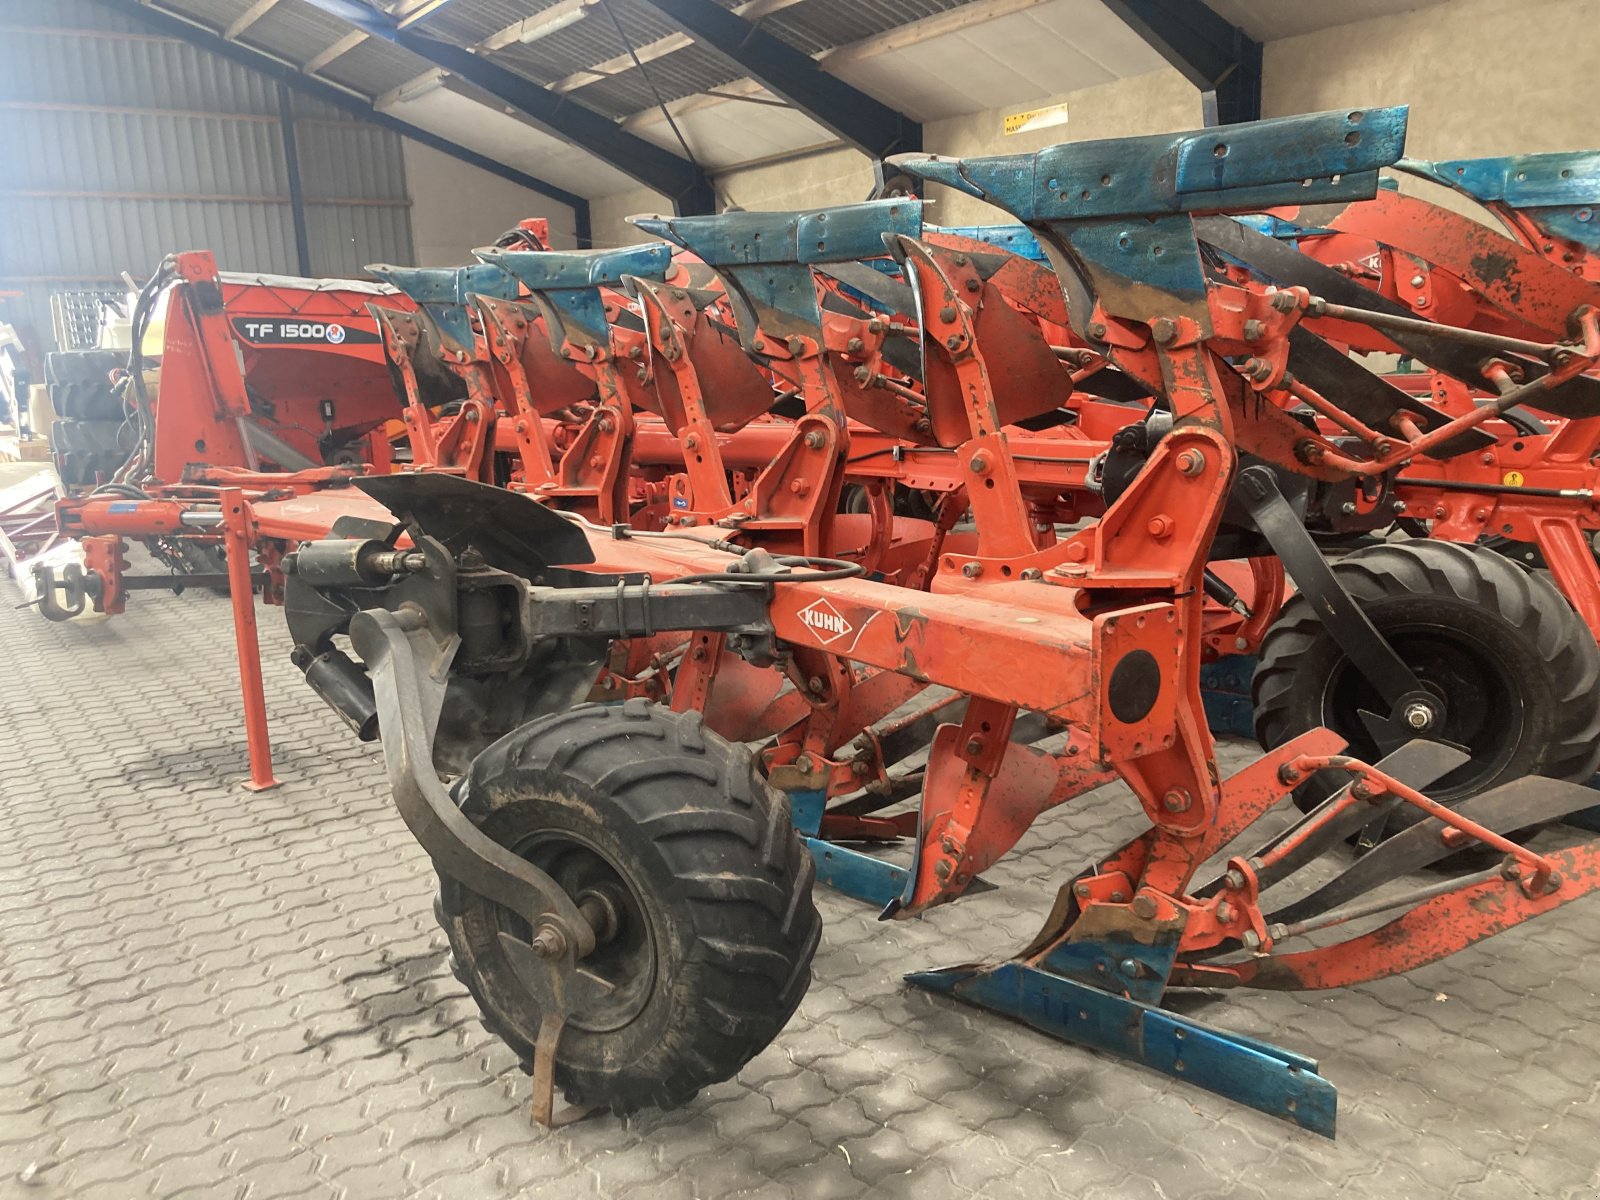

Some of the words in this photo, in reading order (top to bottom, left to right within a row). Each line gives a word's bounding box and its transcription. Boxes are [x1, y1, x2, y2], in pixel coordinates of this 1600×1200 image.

[245, 324, 273, 338] TF
[280, 324, 325, 338] 1500
[804, 608, 844, 634] KUHN
